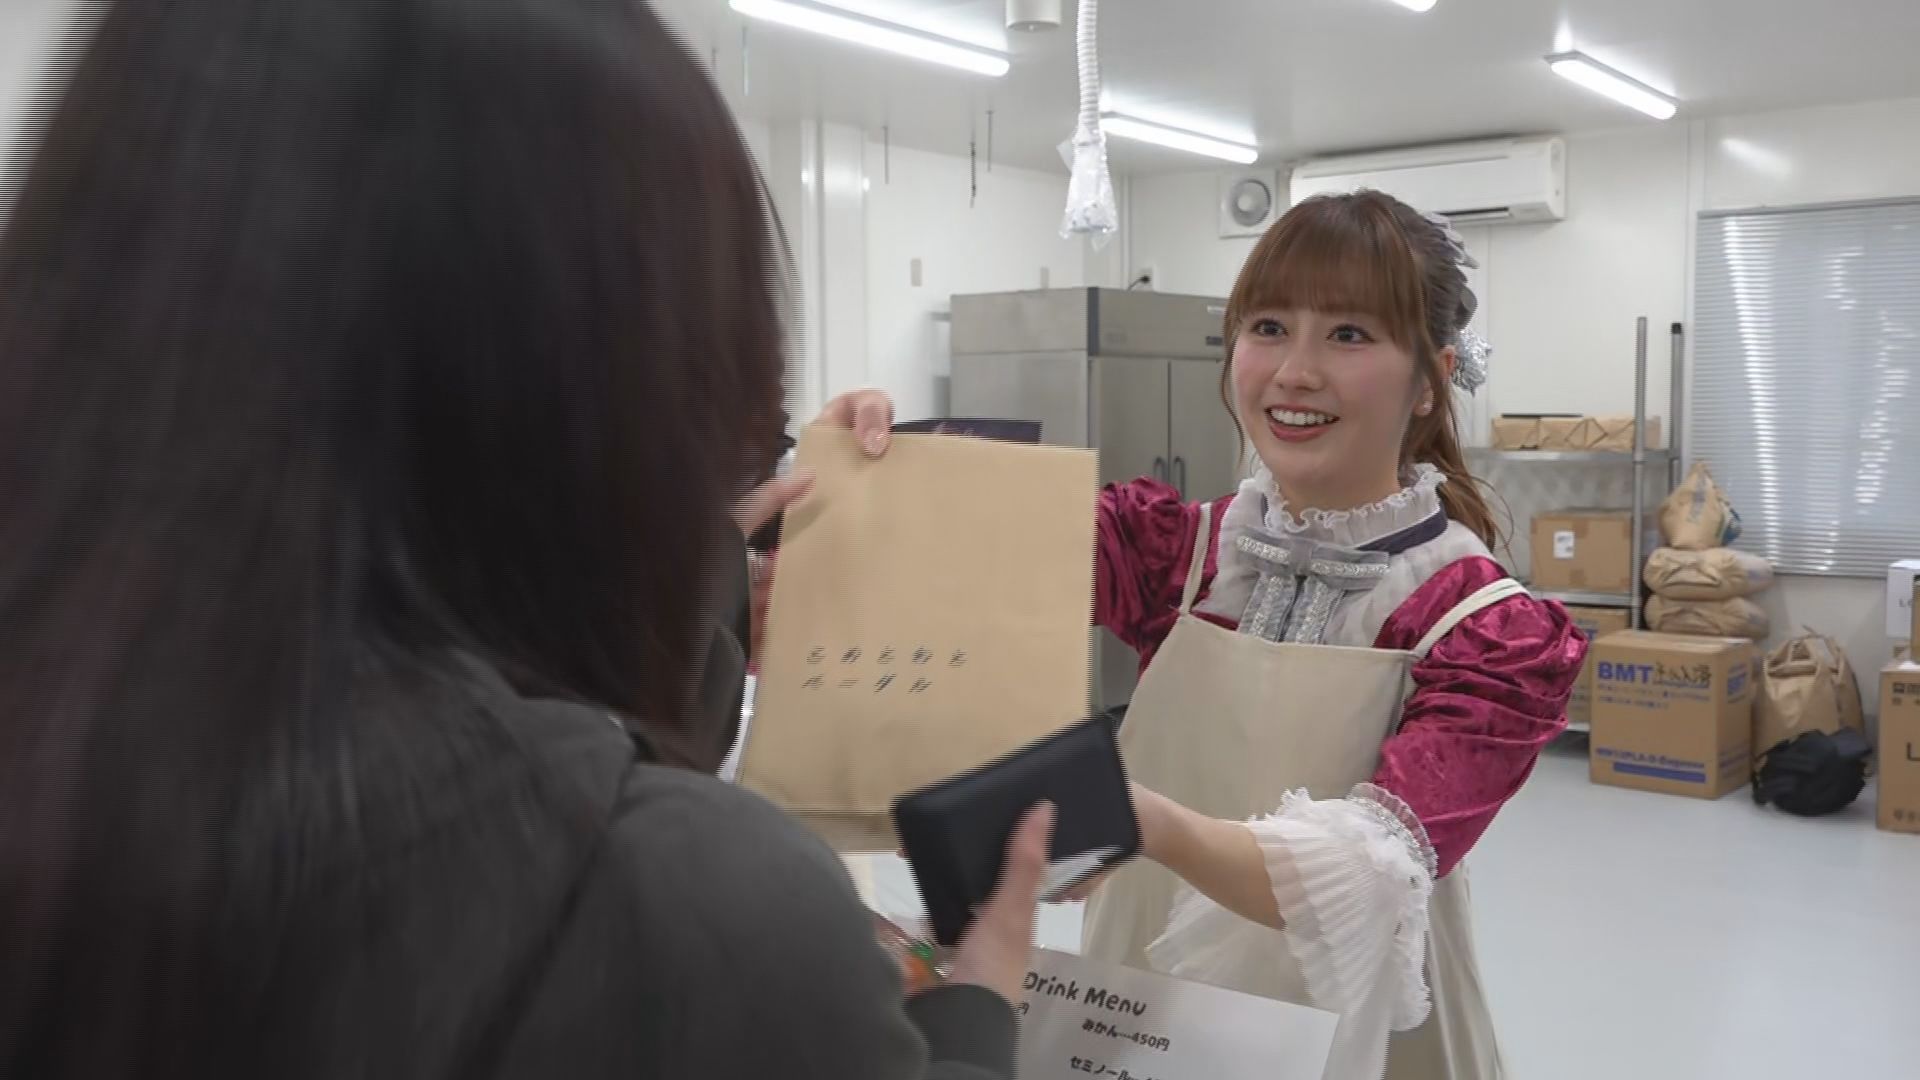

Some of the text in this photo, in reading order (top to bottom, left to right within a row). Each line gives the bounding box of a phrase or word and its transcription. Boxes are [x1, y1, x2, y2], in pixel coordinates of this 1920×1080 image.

[1598, 661, 1654, 684] BMT
[1023, 971, 1147, 1017] Drink Menu
